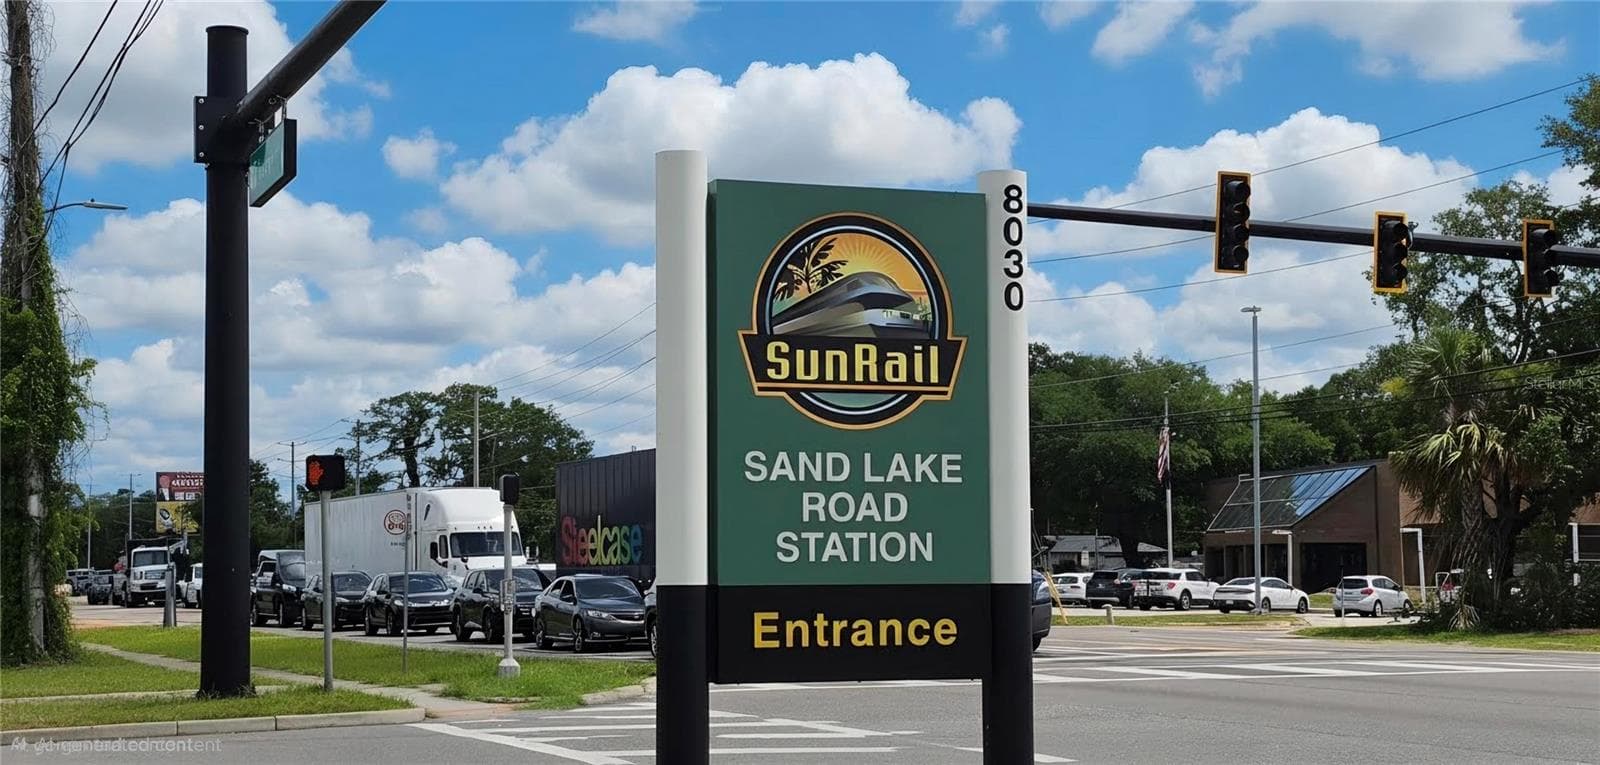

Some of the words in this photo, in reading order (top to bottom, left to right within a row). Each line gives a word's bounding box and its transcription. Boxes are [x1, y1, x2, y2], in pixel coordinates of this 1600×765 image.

[1003, 184, 1024, 311] 8030
[766, 340, 940, 384] SunRail
[744, 451, 851, 482] SAND
[864, 453, 963, 483] LAKE
[802, 492, 908, 523] ROAD
[776, 531, 933, 563] STATION
[753, 611, 958, 649] Entrance
